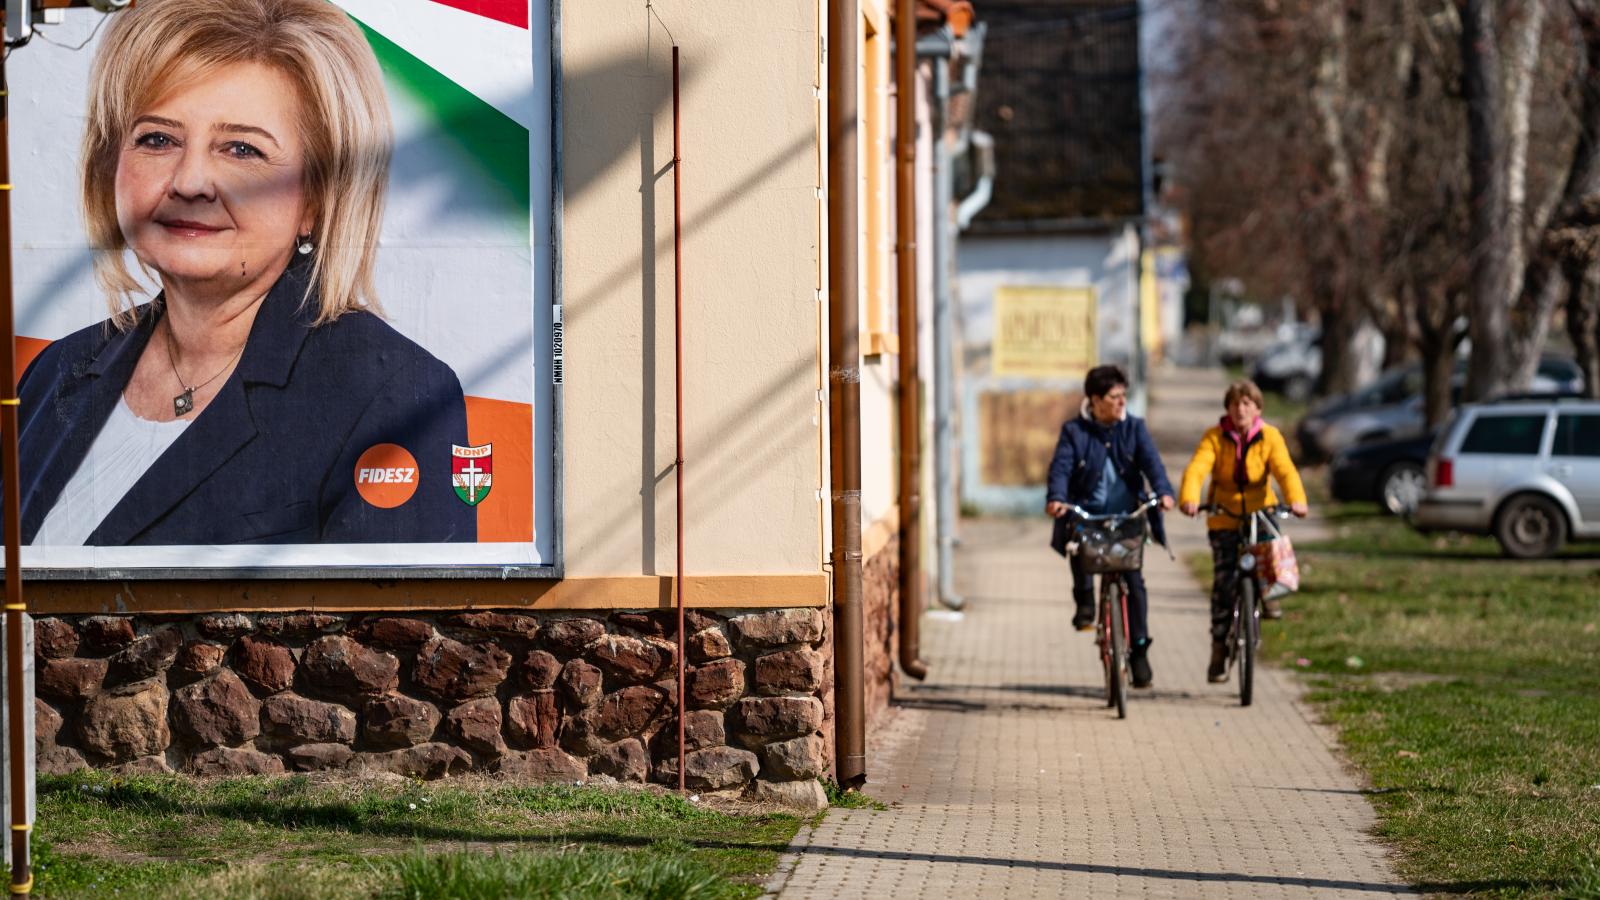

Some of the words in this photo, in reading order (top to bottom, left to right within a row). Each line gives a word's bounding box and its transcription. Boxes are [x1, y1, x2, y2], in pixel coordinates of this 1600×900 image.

[553, 322, 563, 357] 1020970
[553, 359, 563, 383] NMHH
[454, 447, 489, 457] KDNP
[358, 467, 415, 484] FIDESZ
